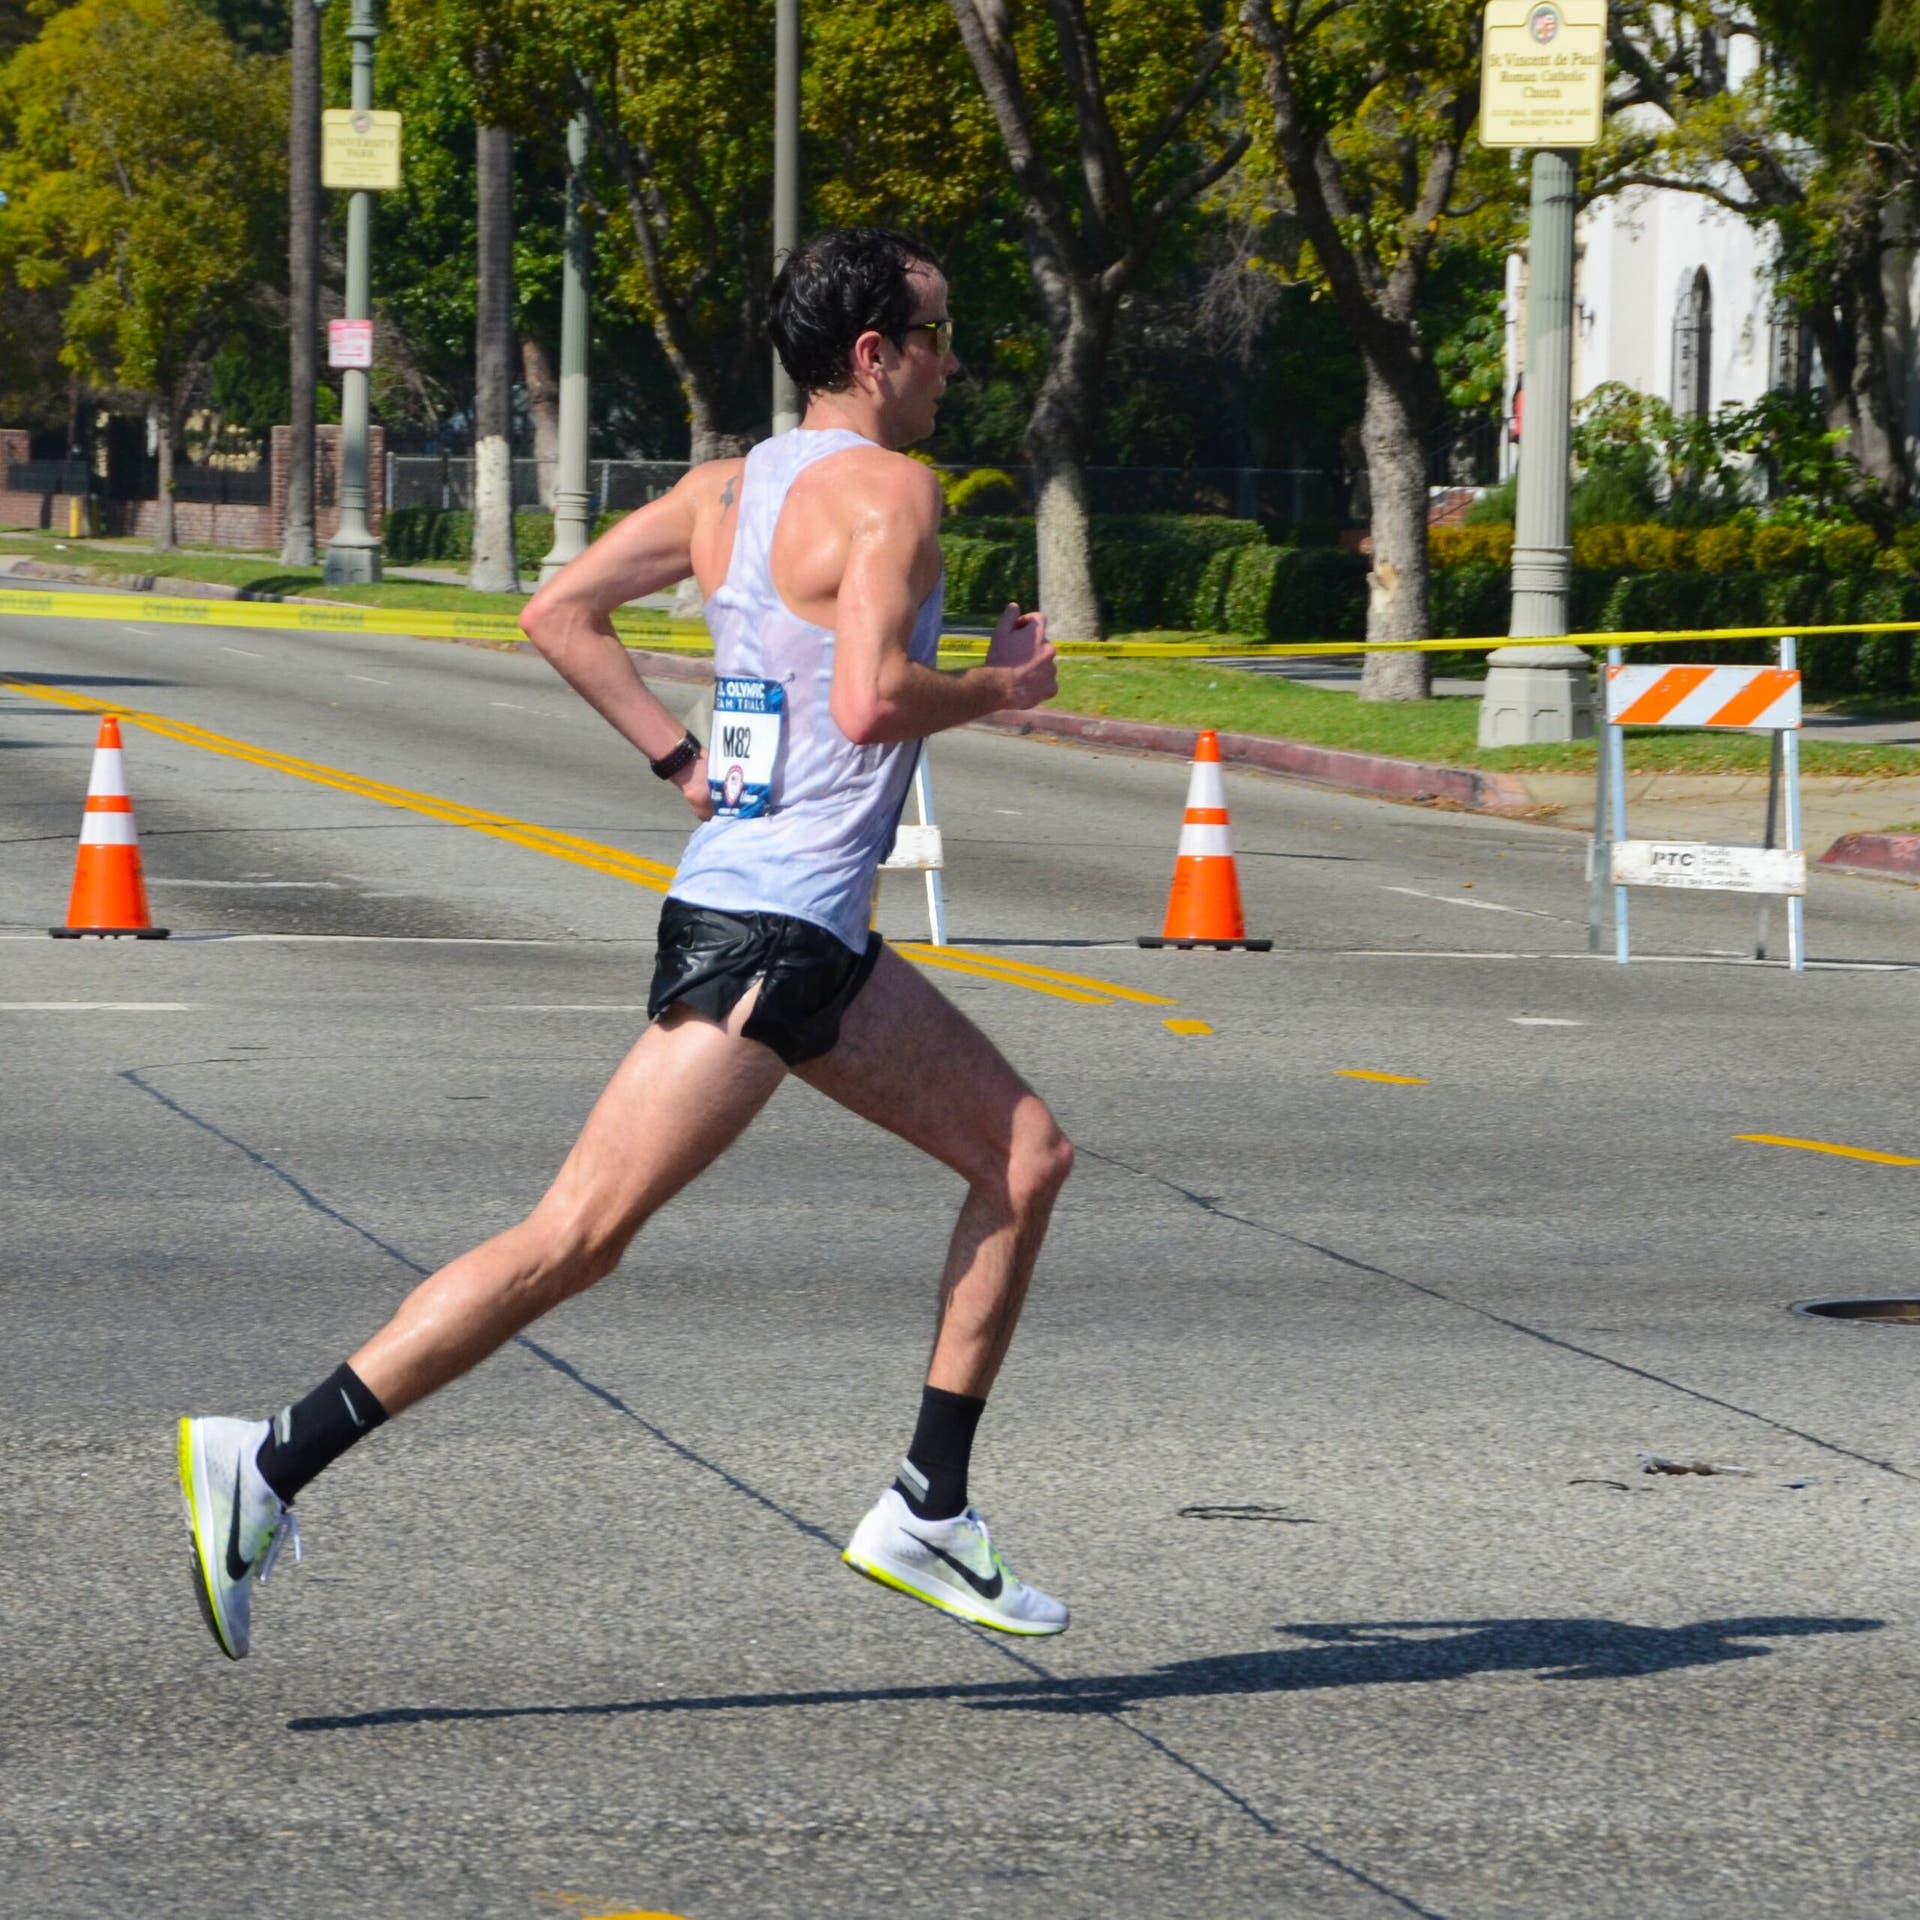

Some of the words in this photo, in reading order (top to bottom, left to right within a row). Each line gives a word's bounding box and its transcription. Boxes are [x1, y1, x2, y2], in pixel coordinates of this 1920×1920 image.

[1504, 53, 1551, 67] Vincent
[1554, 53, 1568, 66] de
[1571, 52, 1600, 66] Paul
[1501, 71, 1537, 82] Roman
[1542, 70, 1586, 82] Catholic
[1523, 87, 1561, 99] Church
[723, 725, 751, 758] M82
[1651, 851, 1695, 867] PTC
